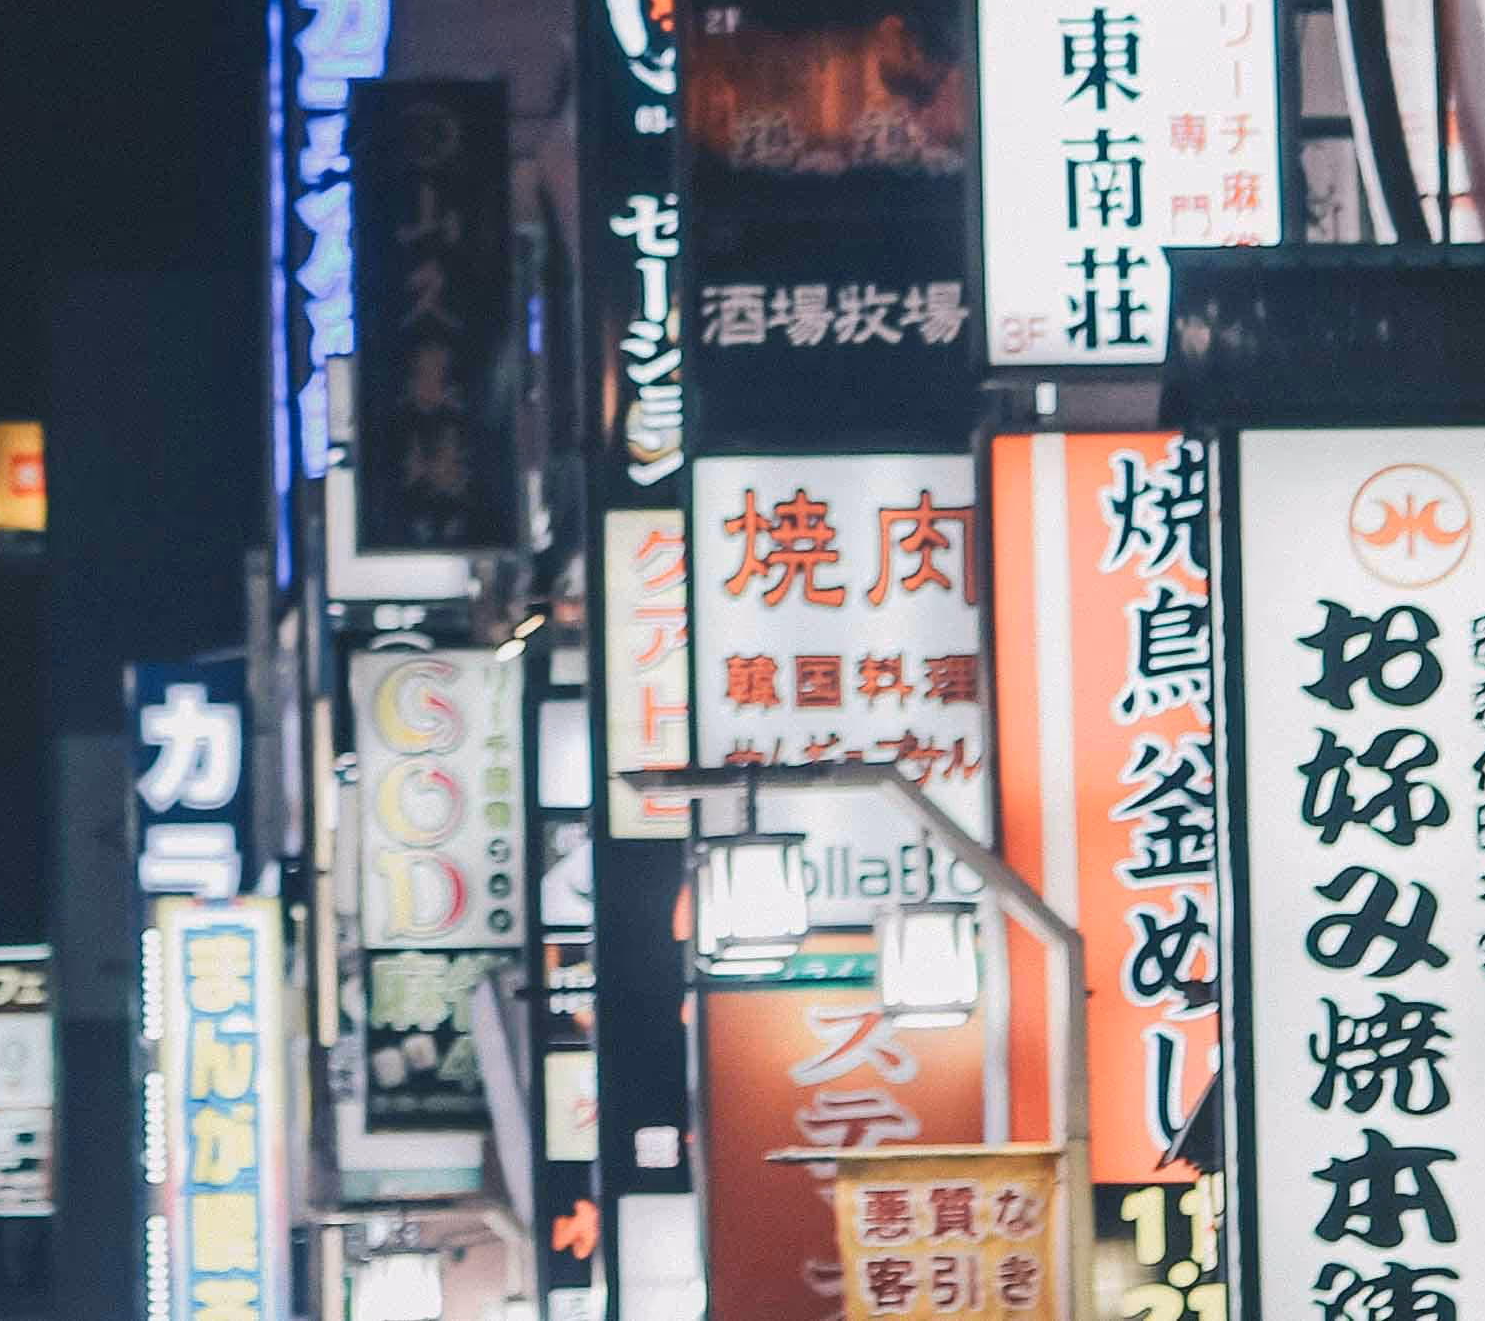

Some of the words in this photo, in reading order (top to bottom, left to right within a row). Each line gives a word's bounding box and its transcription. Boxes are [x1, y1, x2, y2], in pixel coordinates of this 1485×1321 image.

[1058, 6, 1151, 350] 東南荘
[1219, 2, 1262, 247] リーチ麻
[721, 487, 978, 610] 焼肉
[725, 651, 980, 709] 韓国料理
[1100, 438, 1219, 1150] 焼鳥釜めし
[859, 1187, 1045, 1244] 悪質な
[865, 1252, 1042, 1310] 客引き
